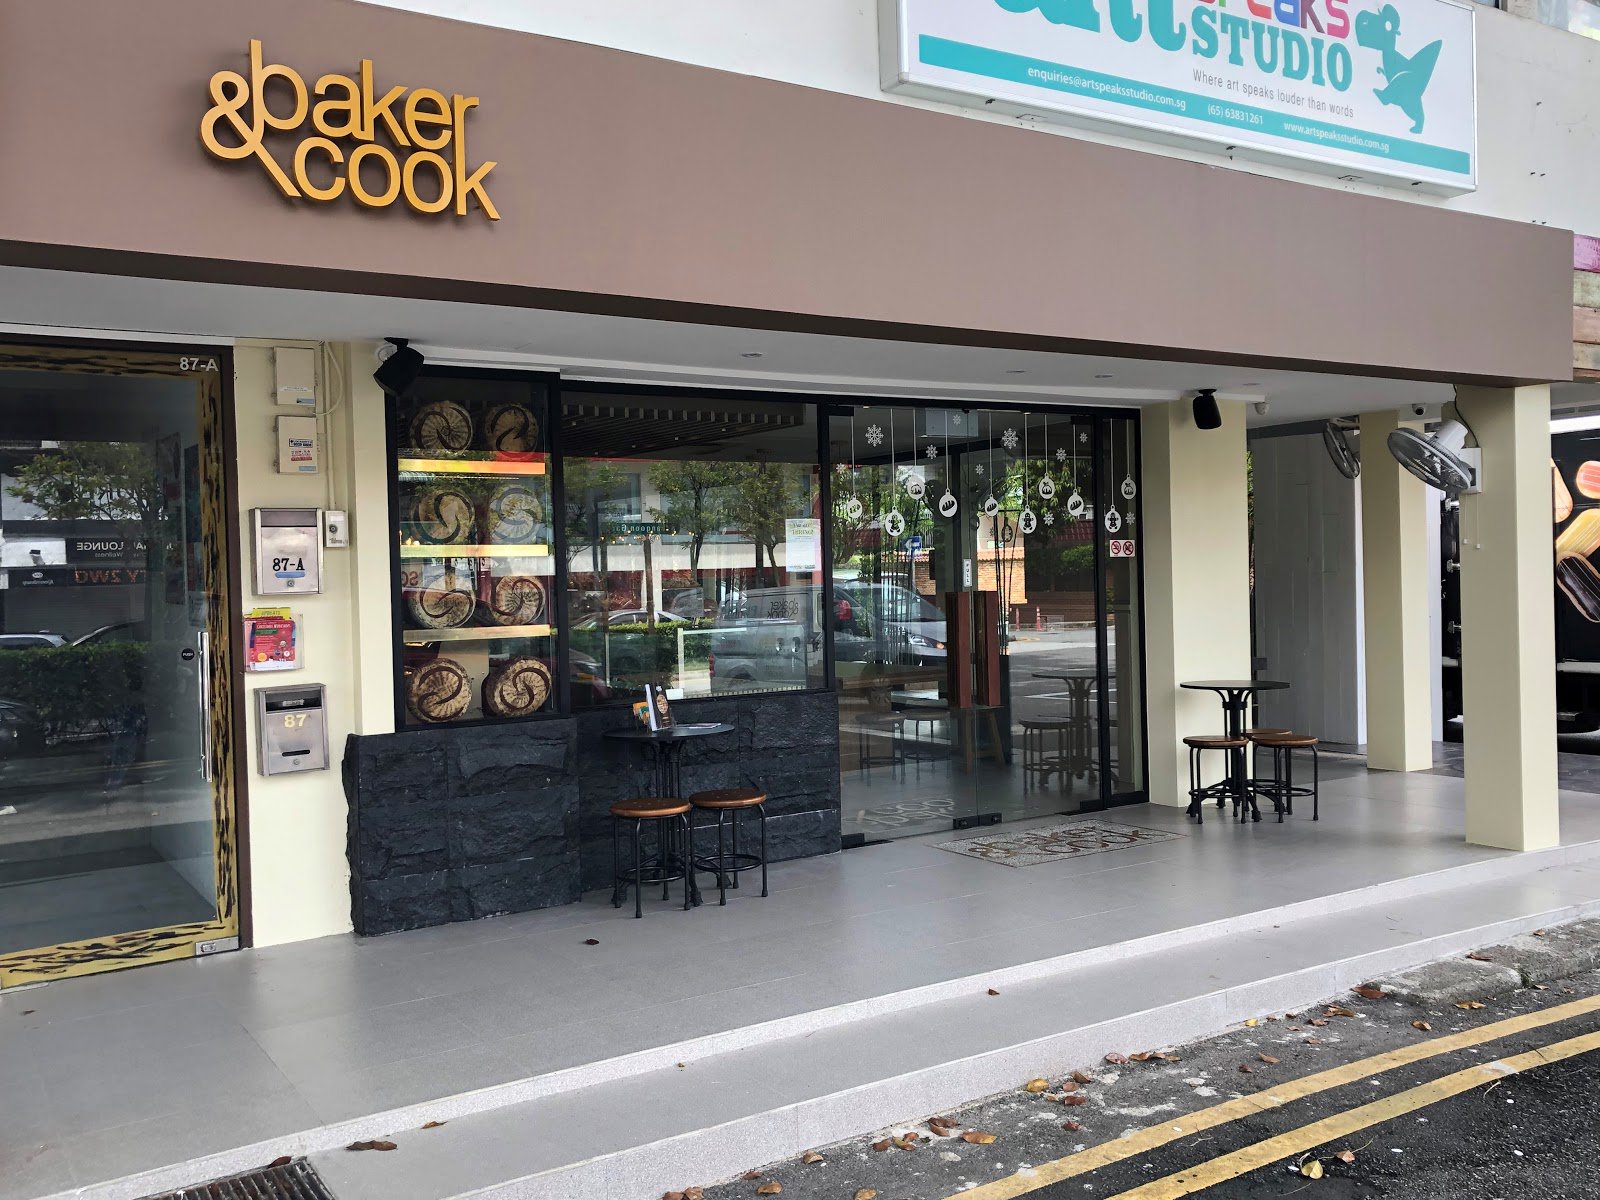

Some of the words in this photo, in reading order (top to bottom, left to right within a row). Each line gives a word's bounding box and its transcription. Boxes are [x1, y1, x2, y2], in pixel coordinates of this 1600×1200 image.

[1191, 5, 1353, 92] STUDIO
[249, 39, 480, 150] baker
[1028, 67, 1187, 111] enquiries@artspeaksstudio.com.sg
[1207, 103, 1224, 118] (65)
[1224, 107, 1264, 125] 63831261
[1283, 121, 1390, 153] www.artspeaksstudio.com.sg
[1193, 68, 1223, 88] Where
[1226, 79, 1239, 92] art
[1243, 83, 1274, 102] speaks
[1277, 89, 1305, 107] louder
[1308, 96, 1327, 112] than
[1329, 102, 1354, 118] words
[200, 70, 302, 198] &
[293, 134, 502, 221] cook
[179, 357, 219, 372] 87-A
[272, 557, 305, 572] 87-A
[284, 713, 307, 728] 87
